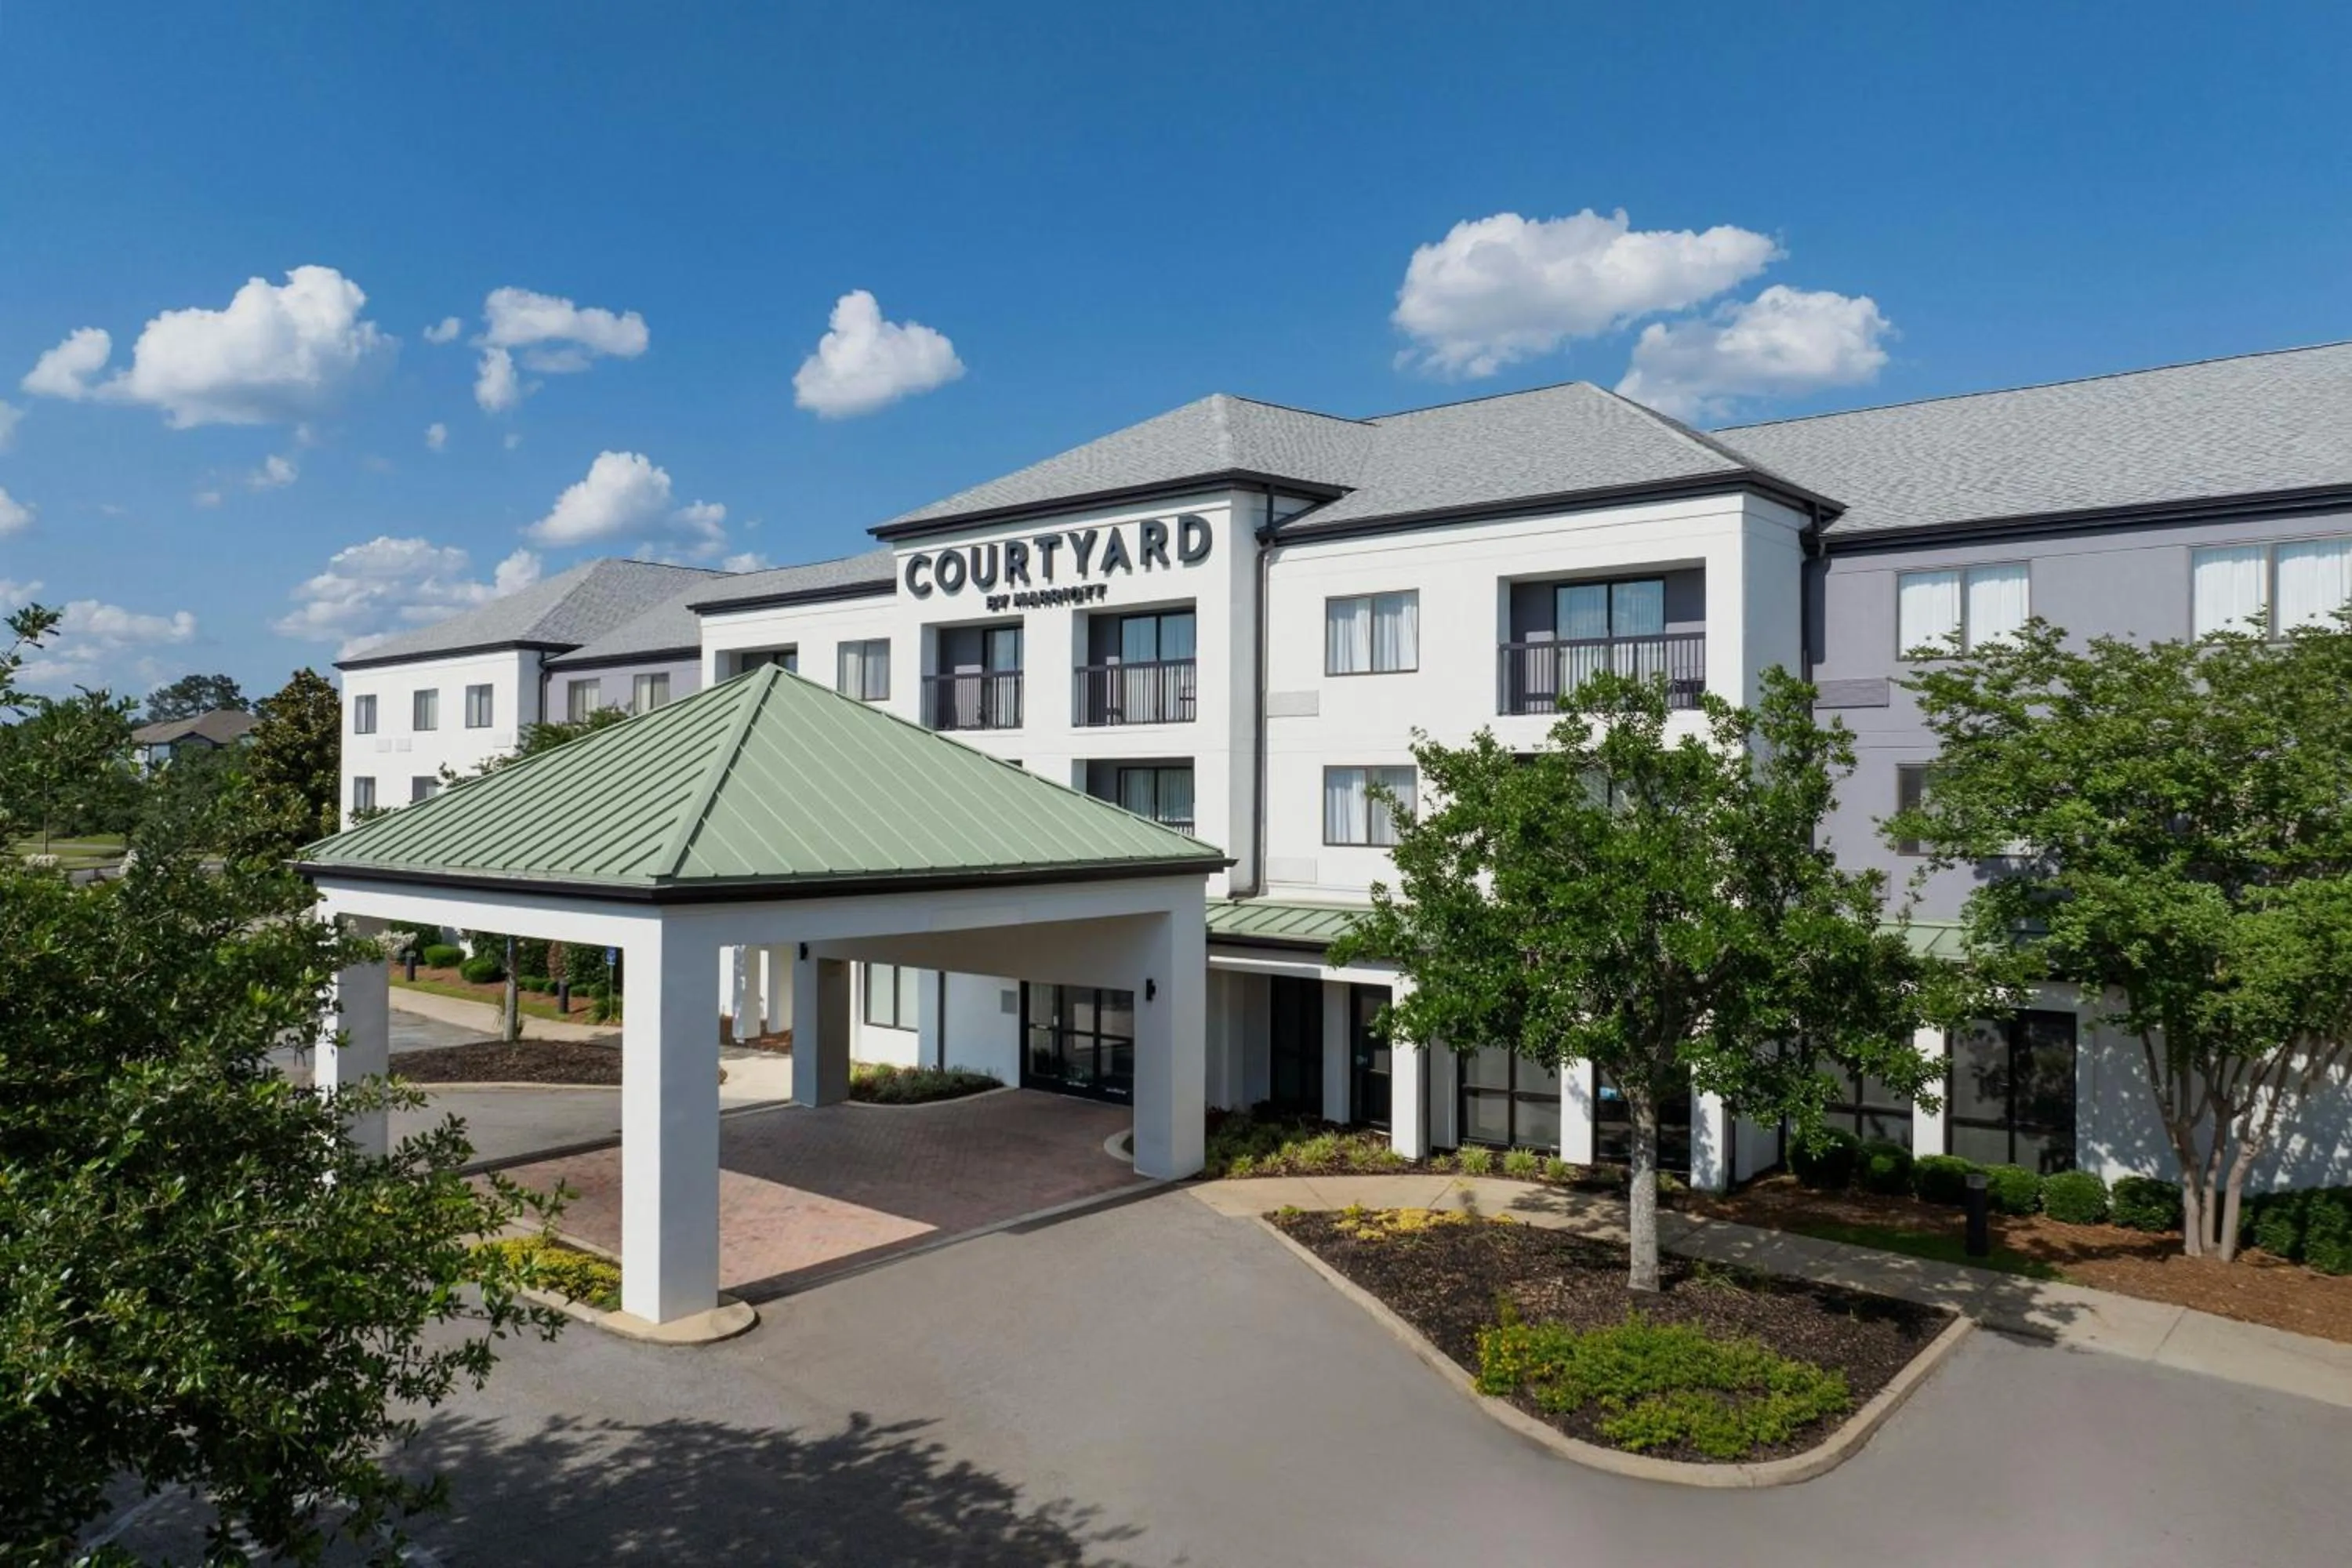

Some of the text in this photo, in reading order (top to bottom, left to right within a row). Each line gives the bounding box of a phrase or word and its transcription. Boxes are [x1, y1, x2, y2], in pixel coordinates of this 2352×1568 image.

[905, 514, 1213, 596] COURTYARD
[986, 583, 1107, 612] BY MARRIOTT
